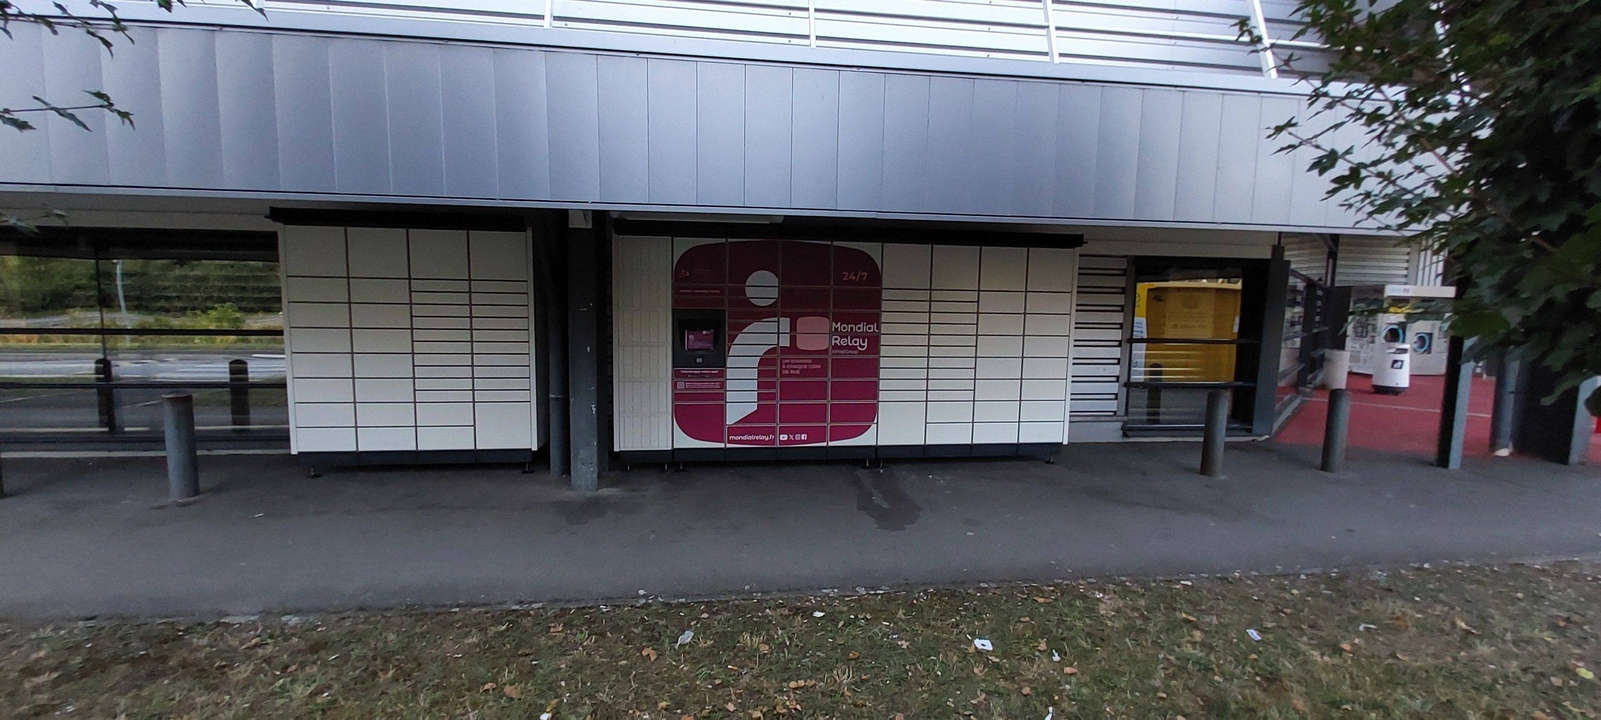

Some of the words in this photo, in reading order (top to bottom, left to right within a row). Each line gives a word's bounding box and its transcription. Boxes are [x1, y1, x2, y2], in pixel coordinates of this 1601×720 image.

[842, 271, 868, 281] 24/7
[832, 321, 879, 332] Mondial
[832, 335, 868, 351] Relay
